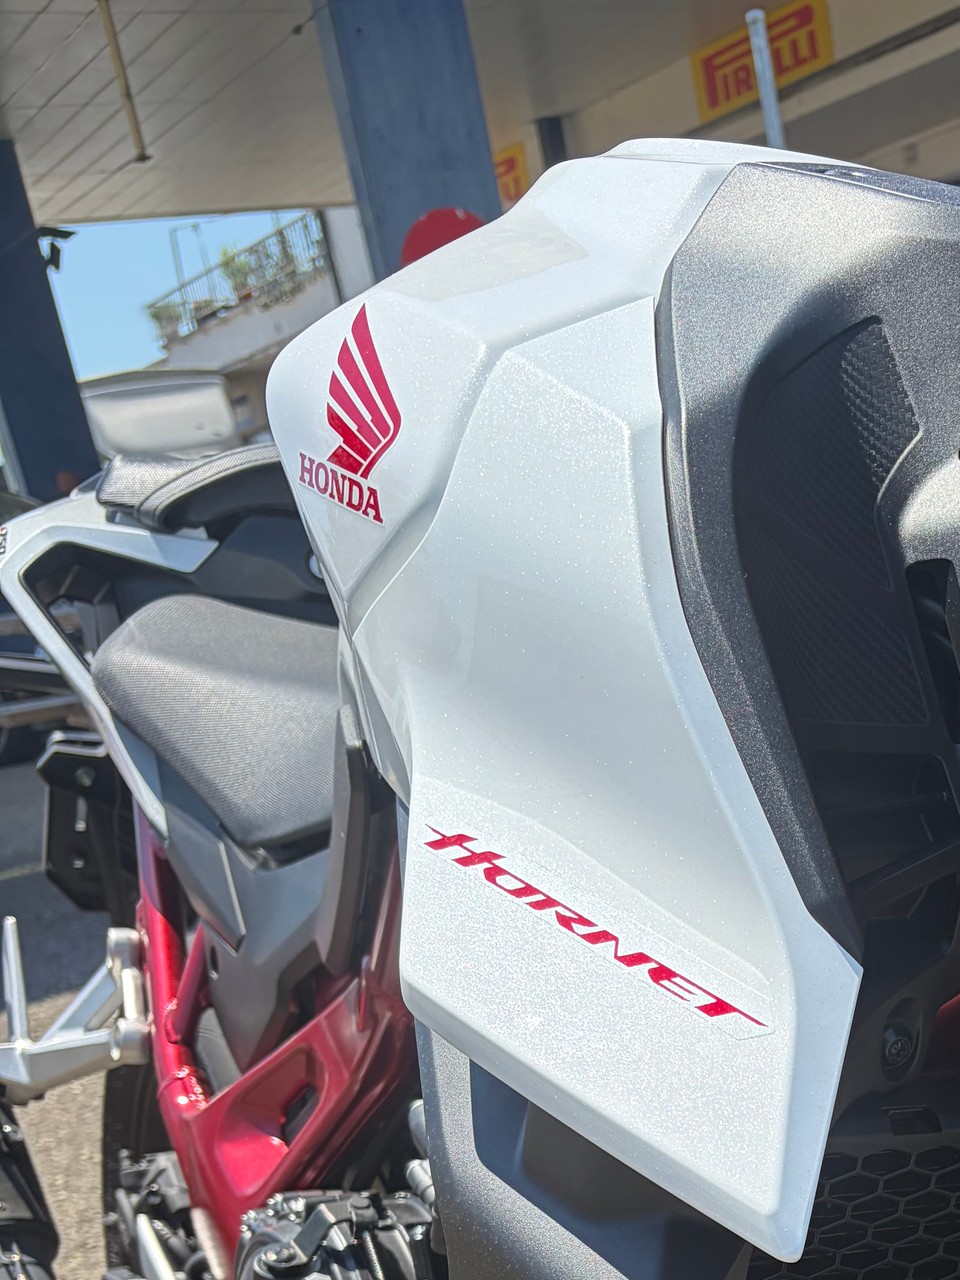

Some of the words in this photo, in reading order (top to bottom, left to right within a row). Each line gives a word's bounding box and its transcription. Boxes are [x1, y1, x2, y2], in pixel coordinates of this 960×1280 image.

[701, 4, 819, 110] PIRLLI
[299, 452, 384, 524] HONDA
[423, 823, 769, 1028] HORNET
